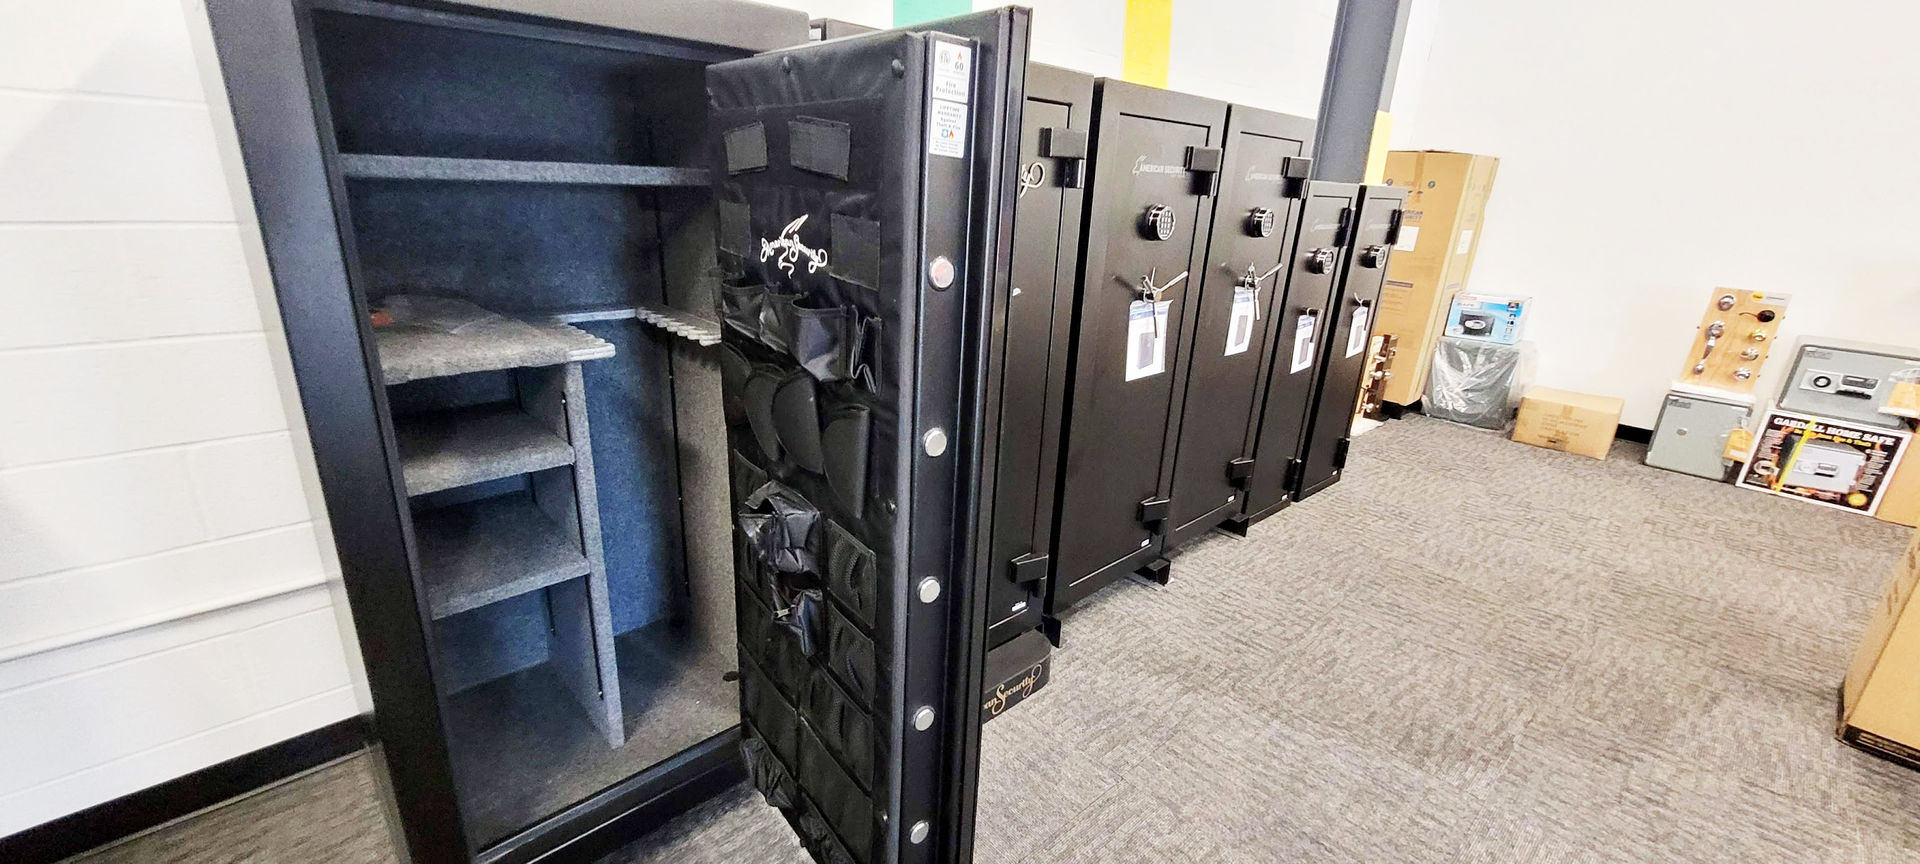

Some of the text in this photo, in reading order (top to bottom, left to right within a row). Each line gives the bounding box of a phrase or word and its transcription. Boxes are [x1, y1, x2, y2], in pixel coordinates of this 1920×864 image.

[954, 61, 964, 71] 60
[945, 80, 957, 88] Fire
[935, 86, 966, 97] Protection
[1825, 426, 1863, 440] HOME
[1862, 434, 1895, 446] SAFE
